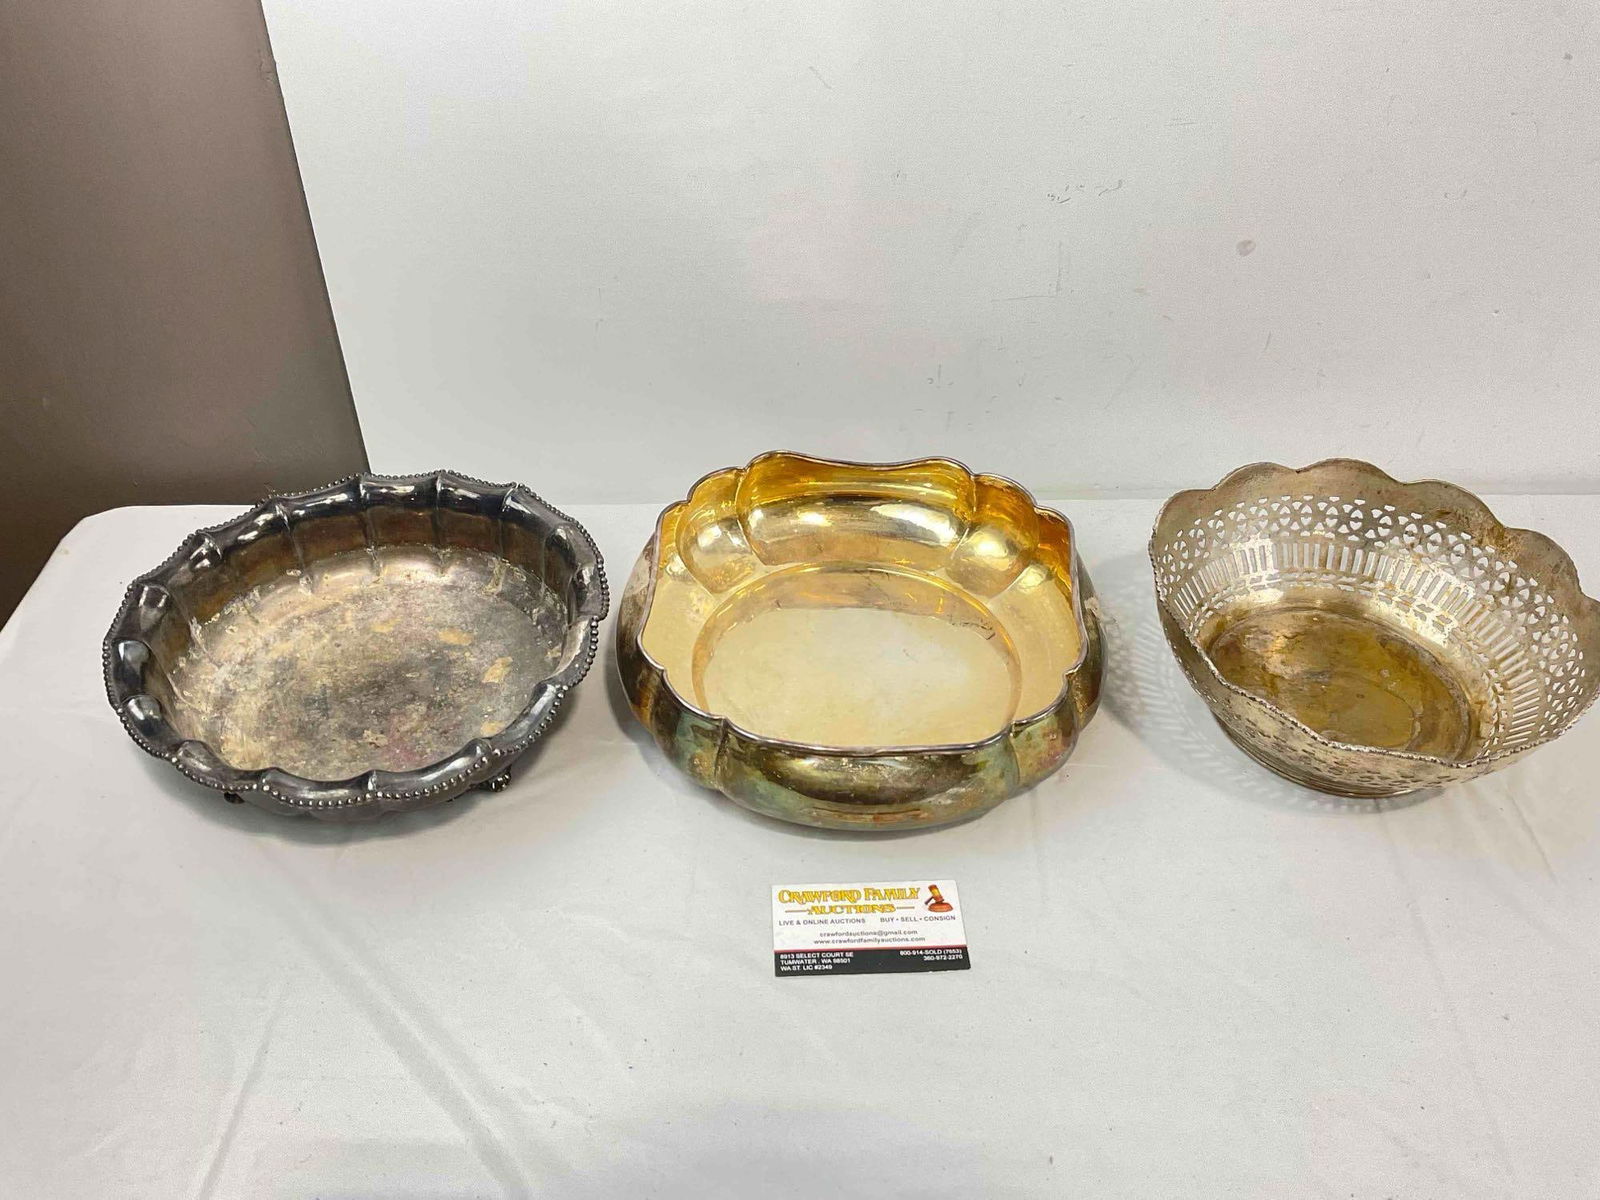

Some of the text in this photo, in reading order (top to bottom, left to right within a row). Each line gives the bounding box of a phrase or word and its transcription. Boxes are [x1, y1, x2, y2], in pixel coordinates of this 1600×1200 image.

[778, 887, 921, 905] CRAWFORD FAMILY
[807, 904, 897, 915] AUCTIONS
